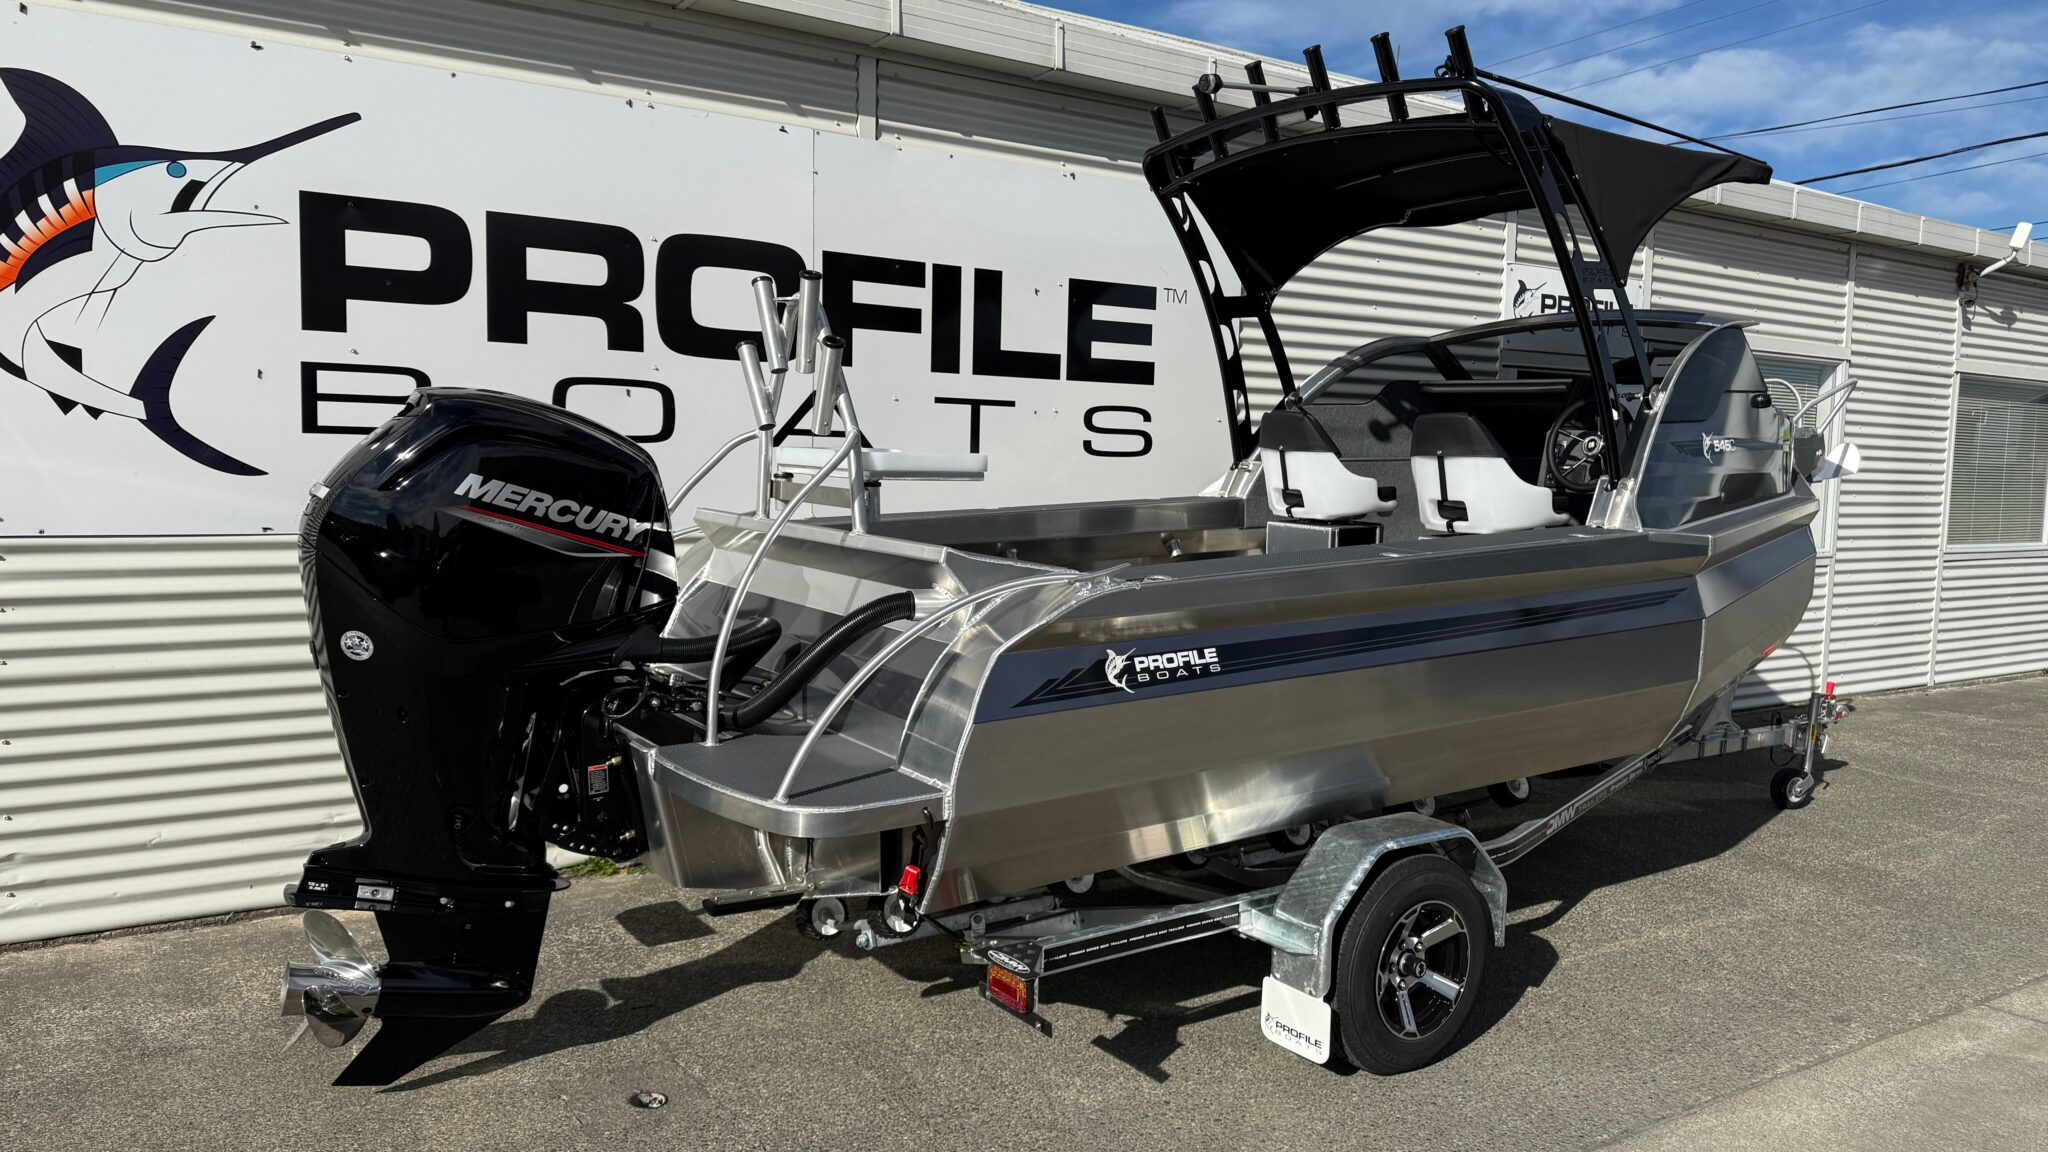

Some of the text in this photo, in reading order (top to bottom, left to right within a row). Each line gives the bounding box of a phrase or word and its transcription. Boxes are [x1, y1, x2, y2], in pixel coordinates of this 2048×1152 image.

[298, 189, 1188, 386] PROFILE TM
[300, 360, 1154, 459] BOATS
[453, 472, 648, 542] MERCURY
[1133, 647, 1219, 672] PROFILE
[1137, 663, 1221, 682] BOATS
[1275, 1020, 1323, 1050] PROFILE
